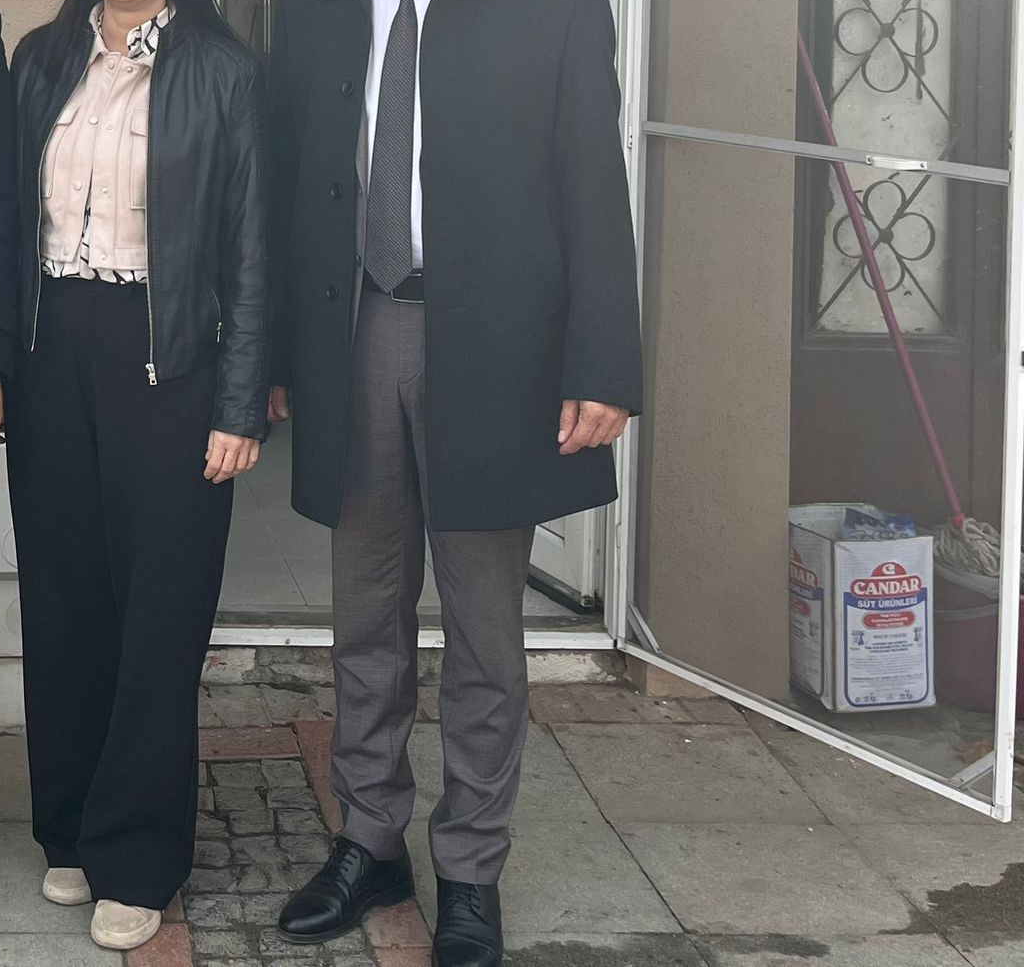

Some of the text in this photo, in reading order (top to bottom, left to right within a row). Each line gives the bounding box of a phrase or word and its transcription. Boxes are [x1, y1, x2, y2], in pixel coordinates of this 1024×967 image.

[853, 578, 921, 596] CANDAR
[857, 596, 918, 609] SÜT ÜRÜNLERİ
